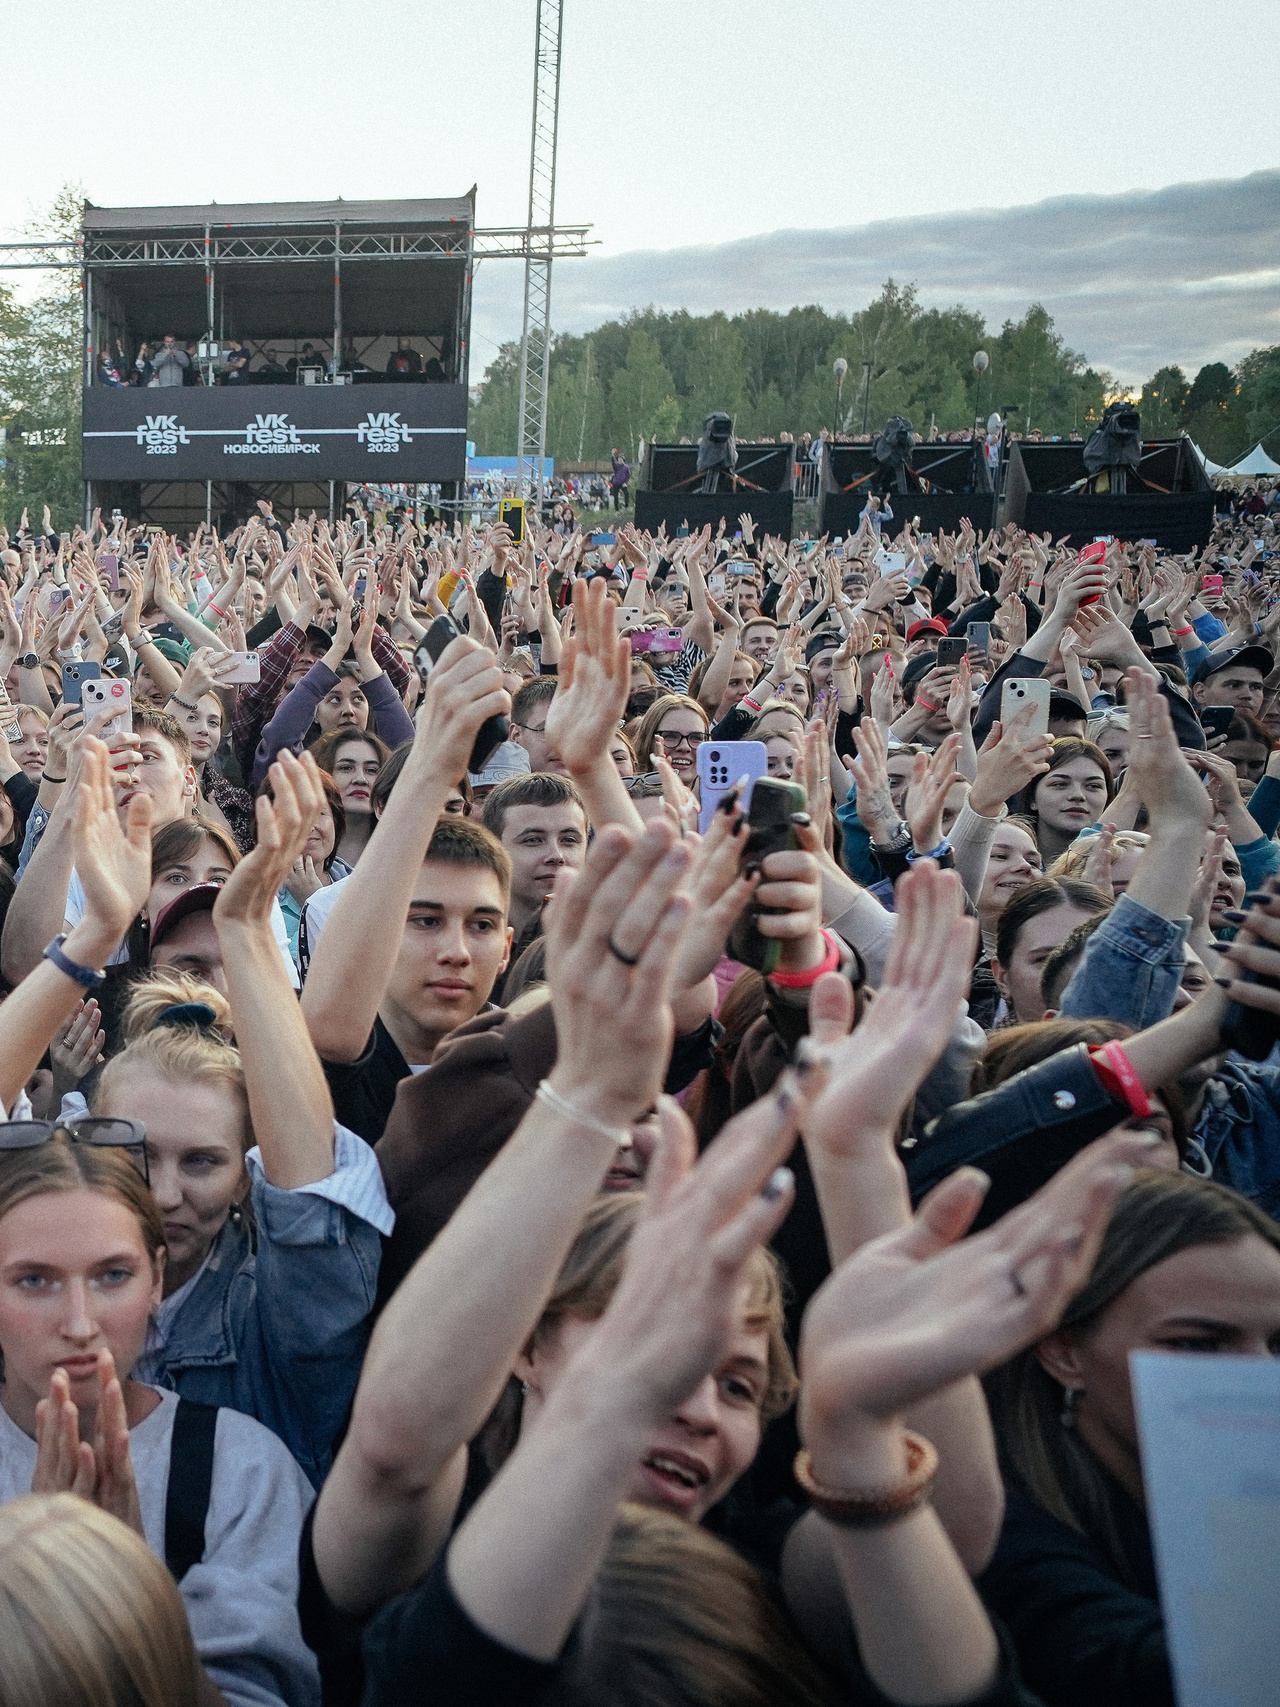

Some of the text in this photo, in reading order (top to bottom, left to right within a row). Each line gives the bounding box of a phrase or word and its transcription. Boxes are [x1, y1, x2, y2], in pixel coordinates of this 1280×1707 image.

[145, 415, 179, 430] VK
[255, 413, 289, 429] VK
[366, 412, 401, 428] VK
[136, 424, 191, 445] fest
[246, 423, 301, 444] fest
[357, 422, 413, 443] fest
[146, 444, 177, 454] 2023
[223, 443, 321, 454] НОВОСИБИРСК
[367, 443, 400, 453] 2023
